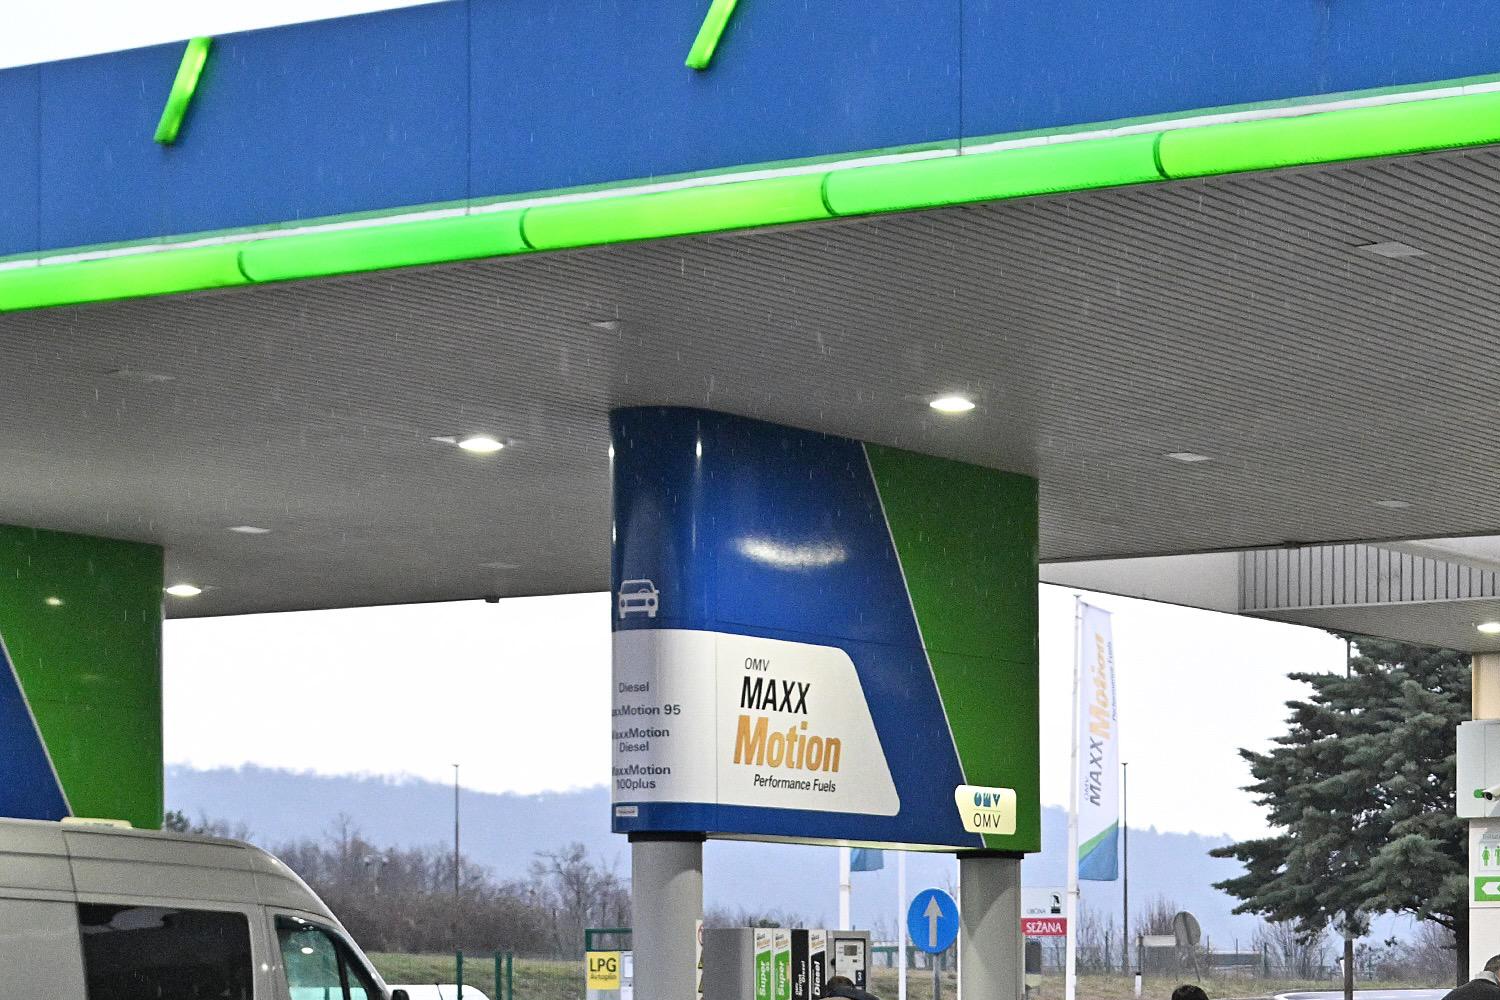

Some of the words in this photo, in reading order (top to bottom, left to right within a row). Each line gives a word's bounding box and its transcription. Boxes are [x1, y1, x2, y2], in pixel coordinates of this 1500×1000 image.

[744, 657, 770, 672] OMV
[618, 681, 650, 693] Diesel
[1089, 632, 1111, 740] Motion
[740, 675, 811, 715] MAXX
[663, 704, 682, 716] 95
[619, 741, 650, 753] Diesel
[733, 714, 842, 773] Motion
[1089, 736, 1104, 807] MAXX
[616, 778, 657, 791] 100plus
[753, 773, 811, 791] Performance
[812, 778, 837, 793] Fuels
[973, 812, 1001, 828] OMV
[1025, 920, 1063, 933] SEŽANA
[590, 957, 617, 972] LPG
[759, 960, 768, 996] Super
[778, 960, 786, 996] Super
[857, 971, 863, 981] 3
